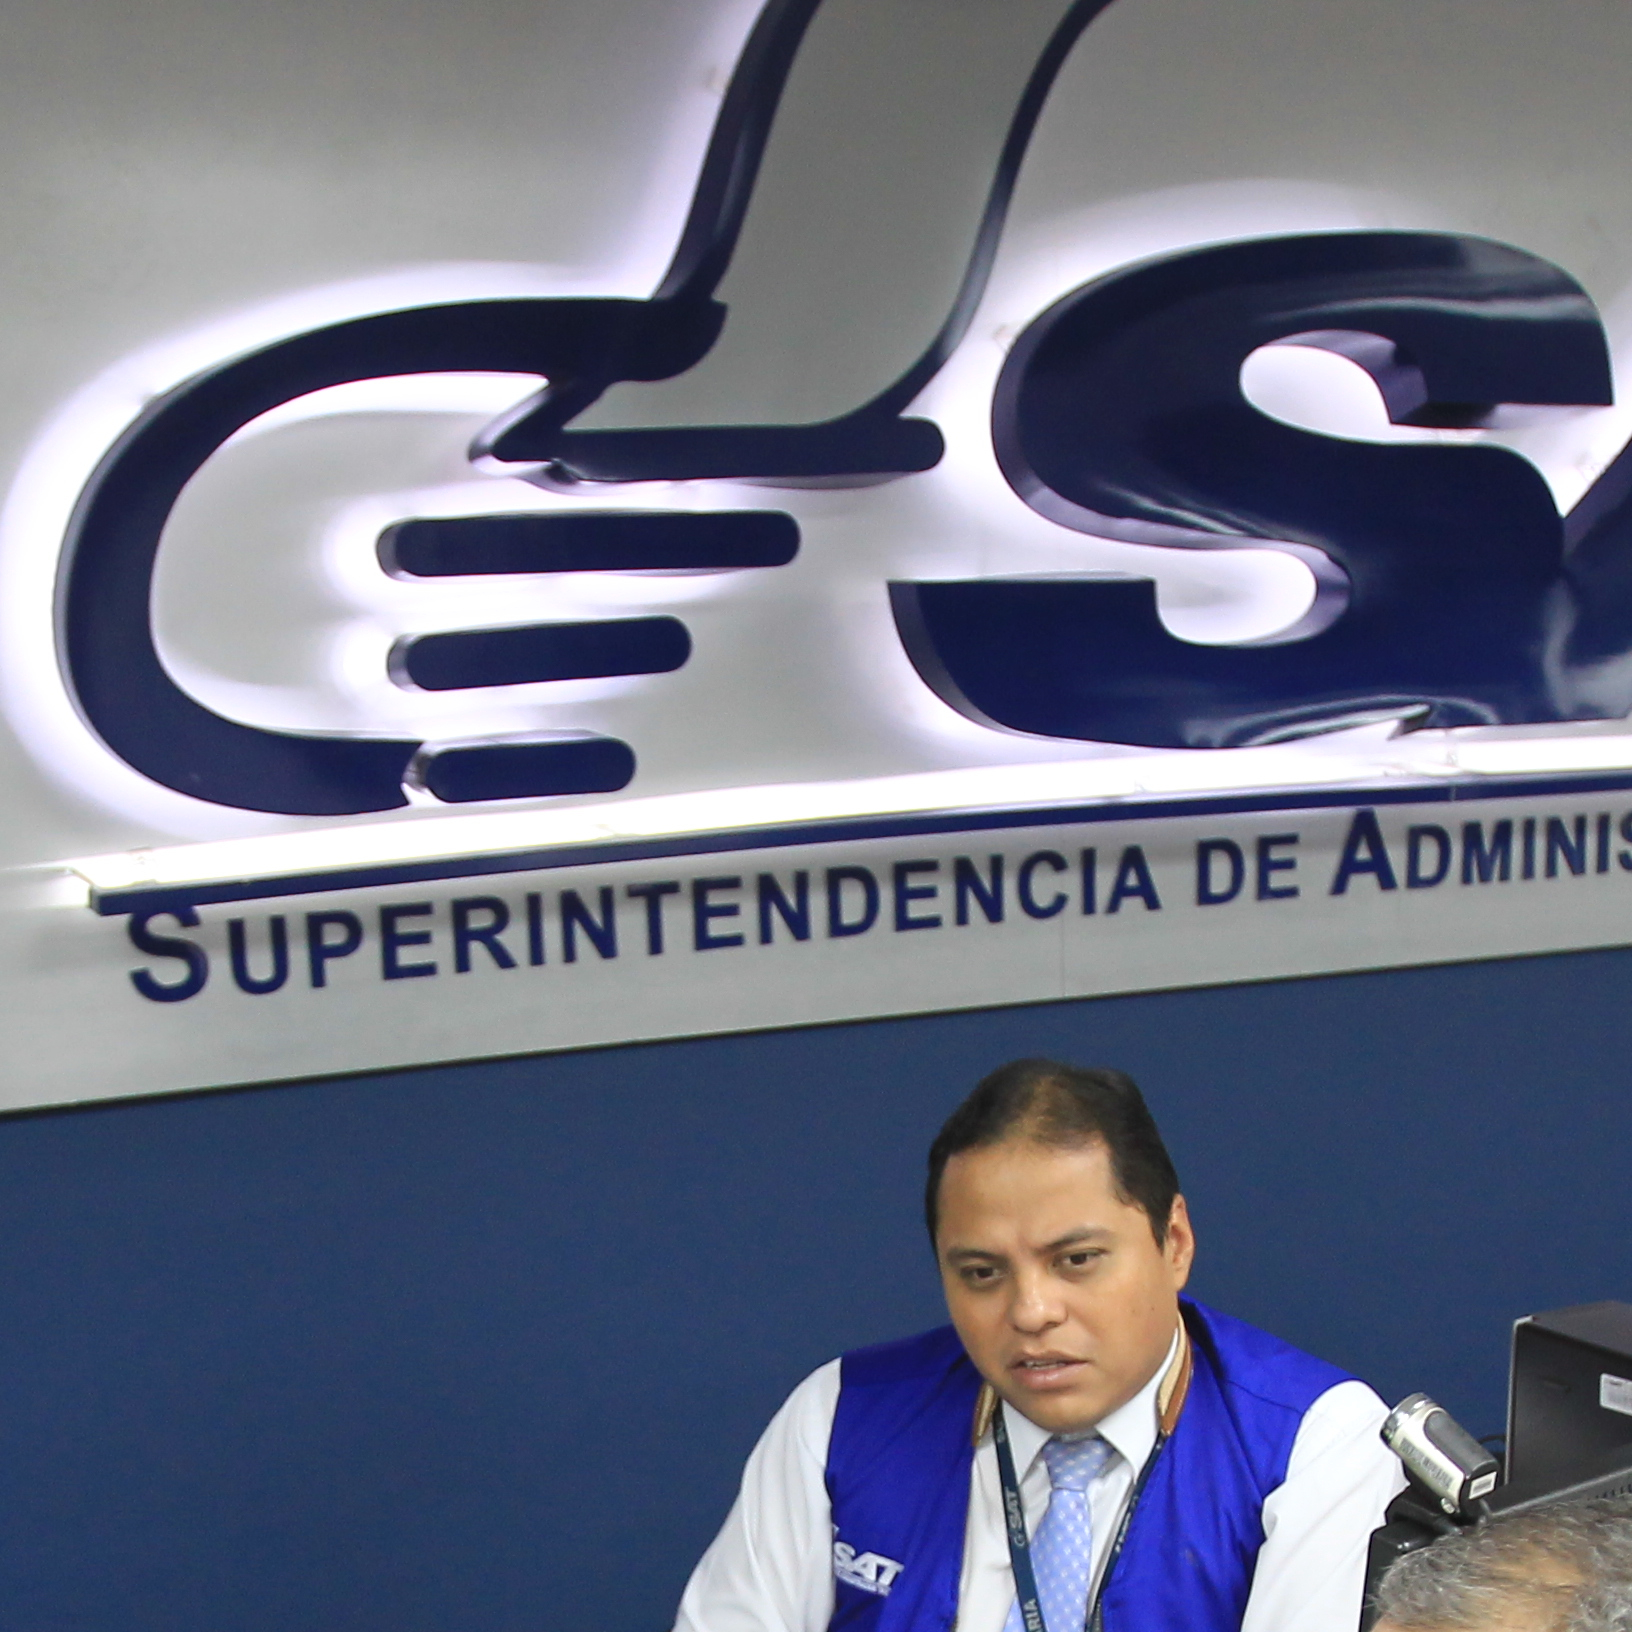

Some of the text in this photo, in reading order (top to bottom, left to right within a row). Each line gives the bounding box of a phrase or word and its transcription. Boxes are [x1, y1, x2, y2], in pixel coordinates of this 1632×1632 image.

[128, 844, 1162, 1002] SUPERINTENDENCIA
[1193, 833, 1301, 908] DE
[834, 1541, 905, 1587] SAT
